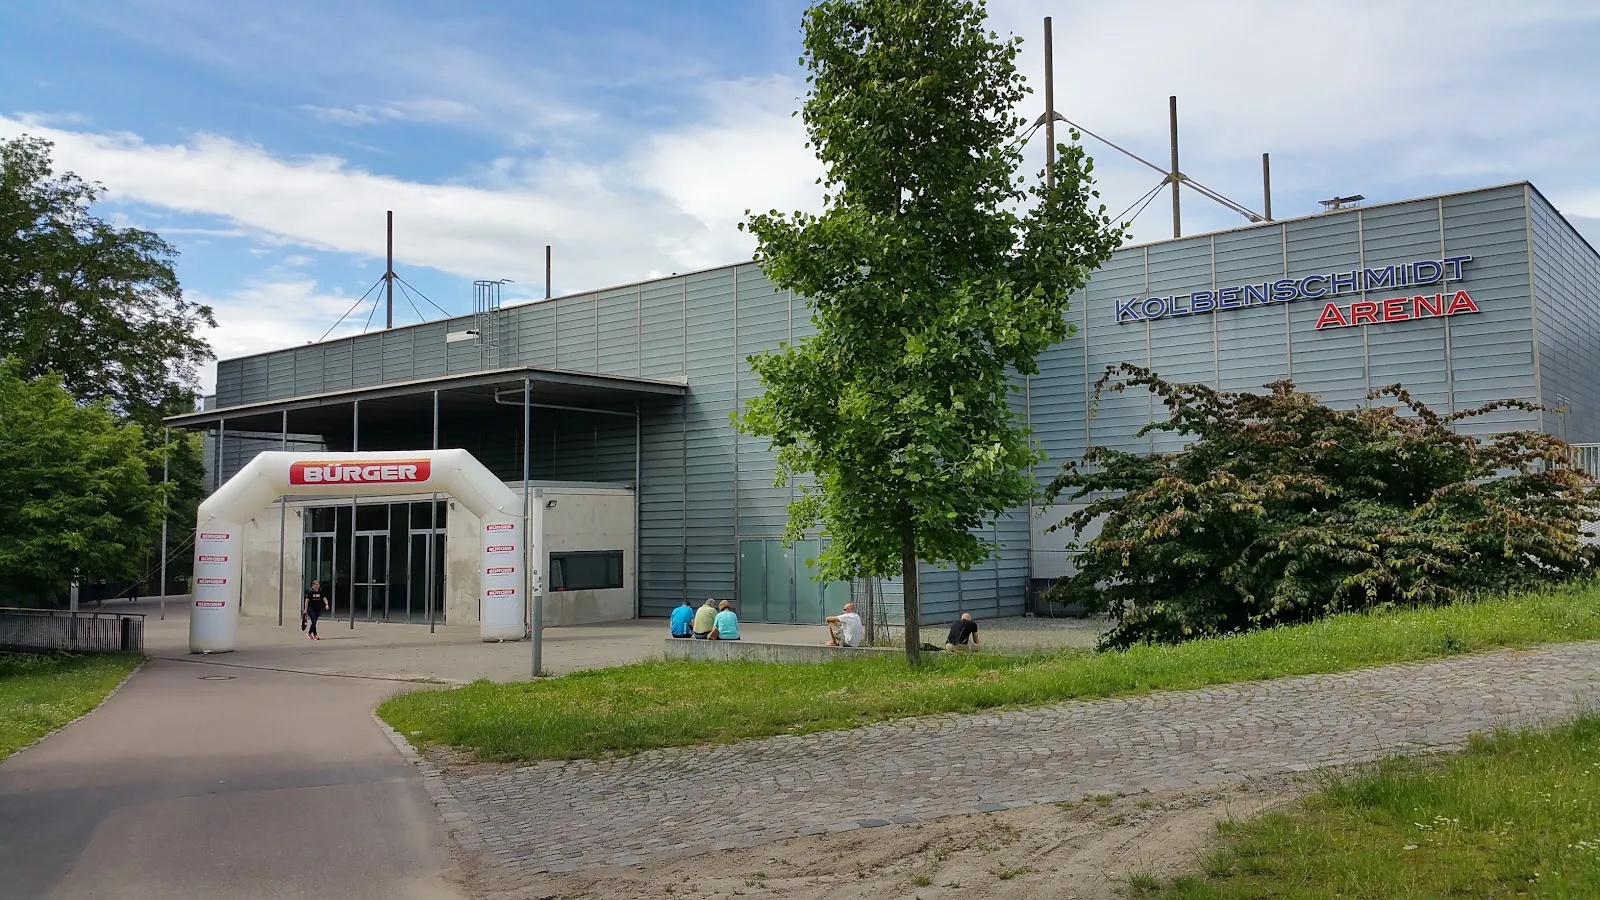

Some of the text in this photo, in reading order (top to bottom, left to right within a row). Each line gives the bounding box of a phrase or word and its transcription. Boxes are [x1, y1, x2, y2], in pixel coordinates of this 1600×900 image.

[1115, 255, 1473, 323] KOLBENSCHMIDT
[1315, 290, 1480, 329] ARENA
[303, 463, 417, 483] BÜRGER
